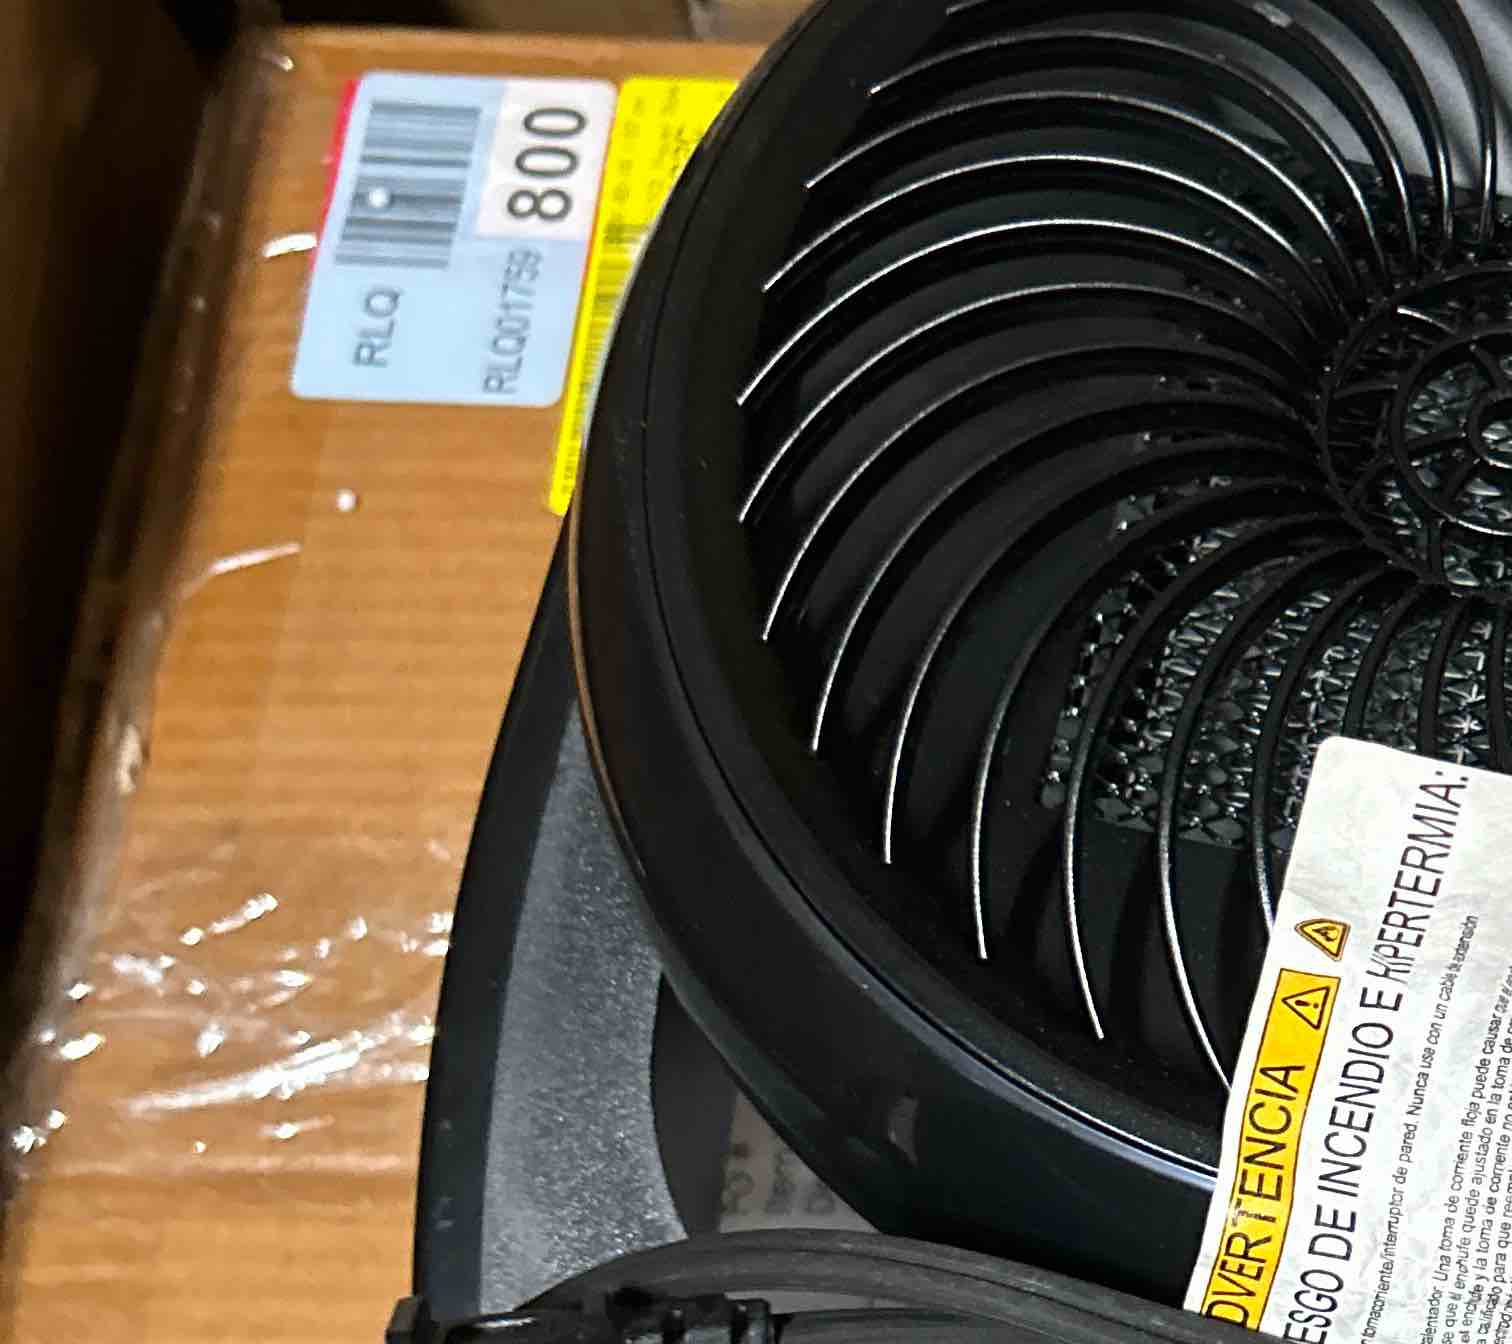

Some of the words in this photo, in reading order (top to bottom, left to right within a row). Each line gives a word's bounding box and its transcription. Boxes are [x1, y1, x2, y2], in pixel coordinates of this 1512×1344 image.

[507, 106, 588, 222] 800
[353, 285, 406, 369] RLQ
[1365, 765, 1469, 984] HIPERTERMIA:
[1358, 984, 1402, 1016] E
[1435, 971, 1457, 1002] cable
[1432, 1003, 1448, 1019] un
[1425, 1021, 1443, 1045] con
[1480, 1013, 1503, 1056] causar
[1418, 1046, 1436, 1069] use
[1490, 1055, 1511, 1090] toma
[1405, 1070, 1431, 1117] Nunca
[1468, 1056, 1494, 1099] puede
[1316, 1016, 1395, 1198] INCENDIO
[1460, 1099, 1483, 1128] floja
[1482, 1107, 1498, 1124] en
[1485, 1091, 1501, 1105] la
[1394, 1117, 1423, 1163] pared.
[1469, 1126, 1493, 1186] ajustado
[1391, 1165, 1409, 1184] de
[1448, 1129, 1473, 1192] corriente
[1205, 1055, 1306, 1328] DVERTENCIA
[1443, 1192, 1461, 1213] de
[1480, 1194, 1498, 1215] de
[1460, 1187, 1480, 1233] quede
[1307, 1201, 1358, 1264] DE
[1439, 1216, 1457, 1252] toma
[1475, 1217, 1494, 1254] toma
[1433, 1253, 1453, 1282] Una
[1472, 1255, 1488, 1270] la
[1492, 1251, 1506, 1283] para
[1441, 1302, 1461, 1328] que
